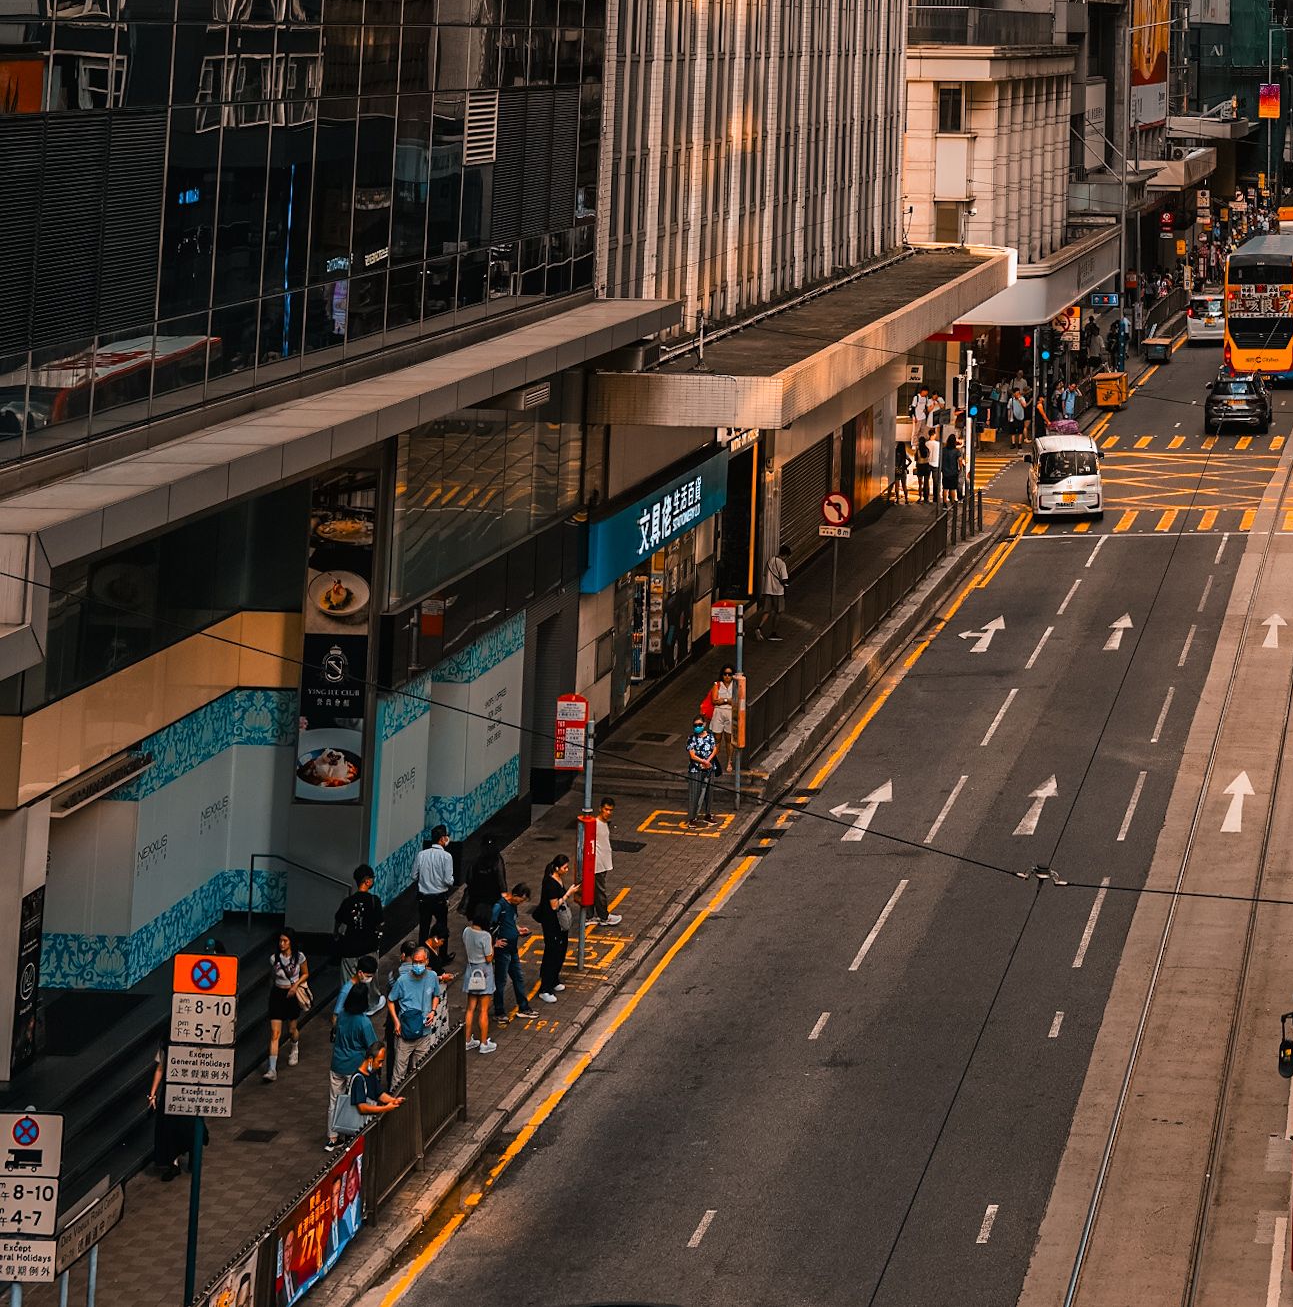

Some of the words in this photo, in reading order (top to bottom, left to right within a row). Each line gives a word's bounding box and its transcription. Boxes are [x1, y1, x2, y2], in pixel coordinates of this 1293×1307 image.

[673, 476, 702, 515] 生活百貨
[176, 1005, 192, 1014] 上午
[195, 1000, 231, 1017] 8-10
[175, 1028, 190, 1037] 下午
[194, 1023, 221, 1038] 5-7
[189, 1050, 213, 1060] Except
[171, 1058, 198, 1066] General
[200, 1059, 230, 1068] Holidays
[170, 1068, 229, 1080] 公眾假期例外
[181, 1087, 203, 1096] Except
[13, 1184, 54, 1202] 8-10
[10, 1210, 42, 1226] 4-7
[3, 1243, 32, 1254] Except
[16, 1254, 52, 1267] Holidays
